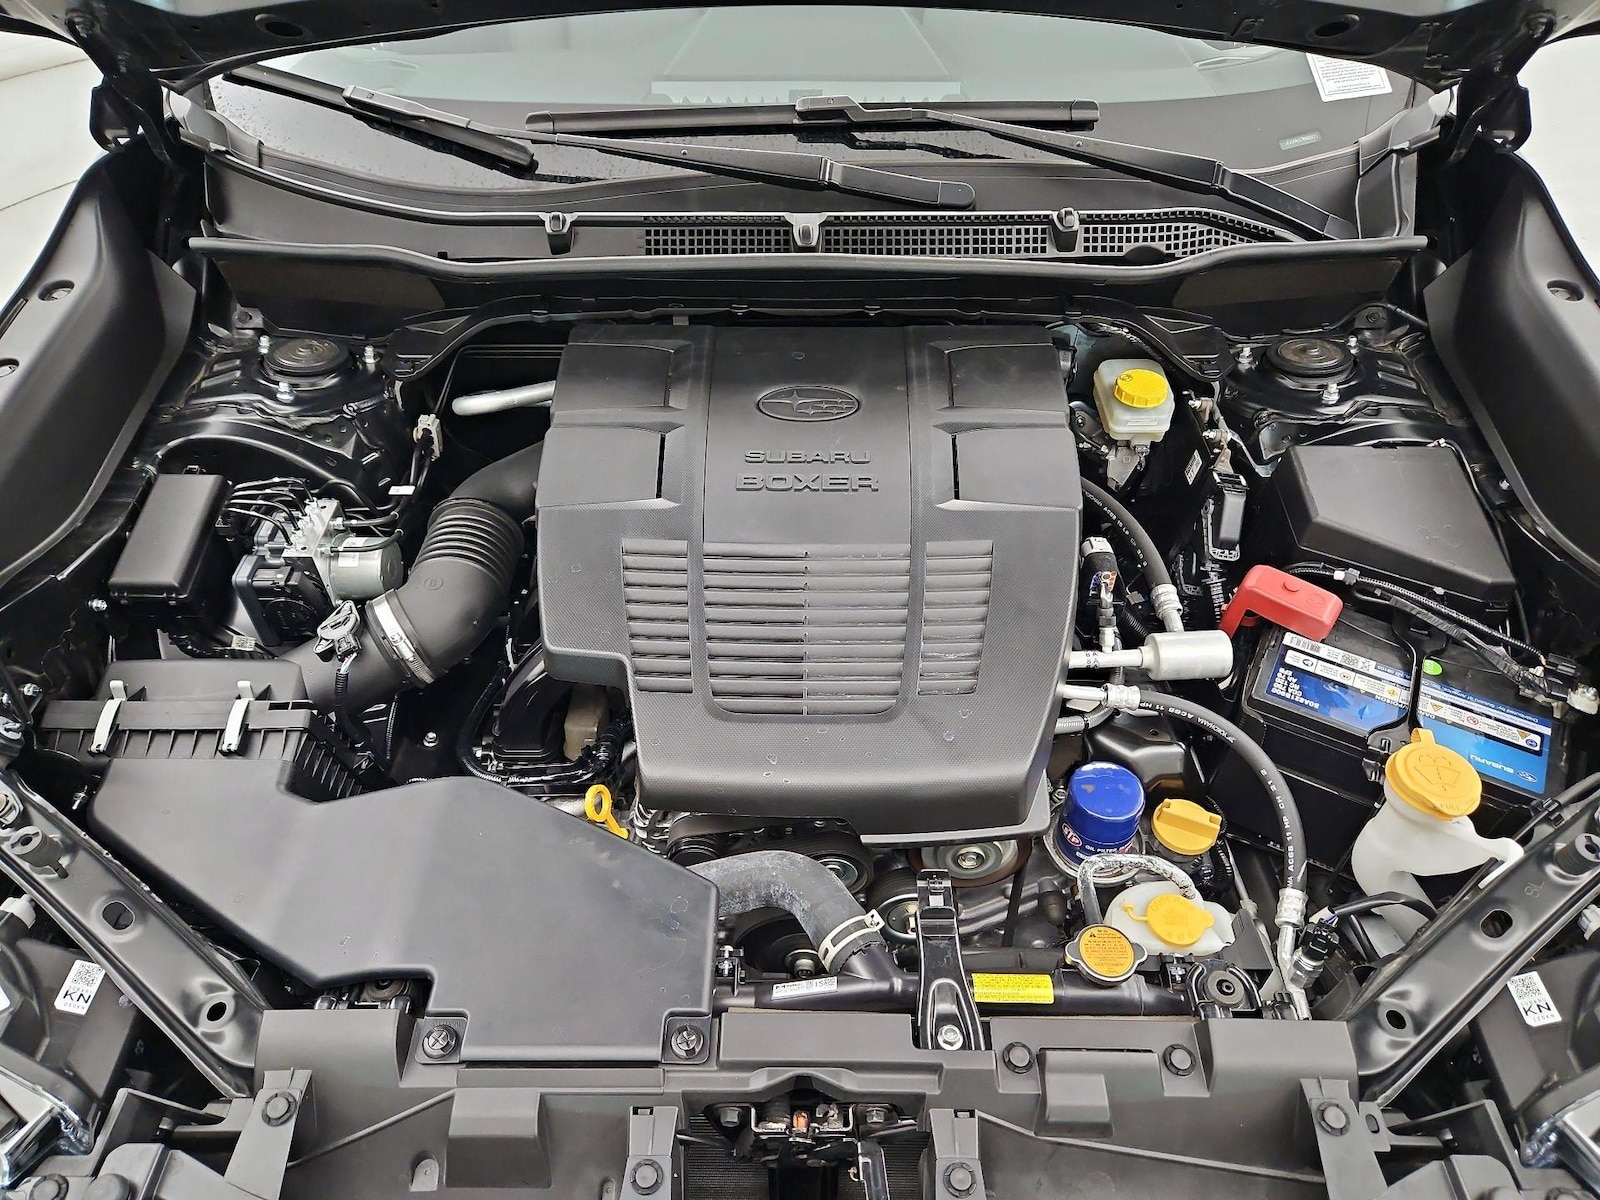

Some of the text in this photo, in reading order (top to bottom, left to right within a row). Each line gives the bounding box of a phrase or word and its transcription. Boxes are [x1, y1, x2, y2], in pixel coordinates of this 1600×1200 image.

[744, 450, 871, 464] SUBARU
[735, 473, 879, 492] BOXER
[1139, 701, 1153, 709] HP
[1197, 717, 1228, 738] YOKOHAMA
[1470, 754, 1515, 774] SUBARU
[1275, 795, 1285, 810] CH
[1282, 815, 1291, 829] HP
[1063, 825, 1081, 845] STP
[1286, 831, 1293, 842] 11
[1084, 844, 1096, 852] OIL
[62, 989, 92, 1004] KN
[1523, 1001, 1552, 1016] KN
